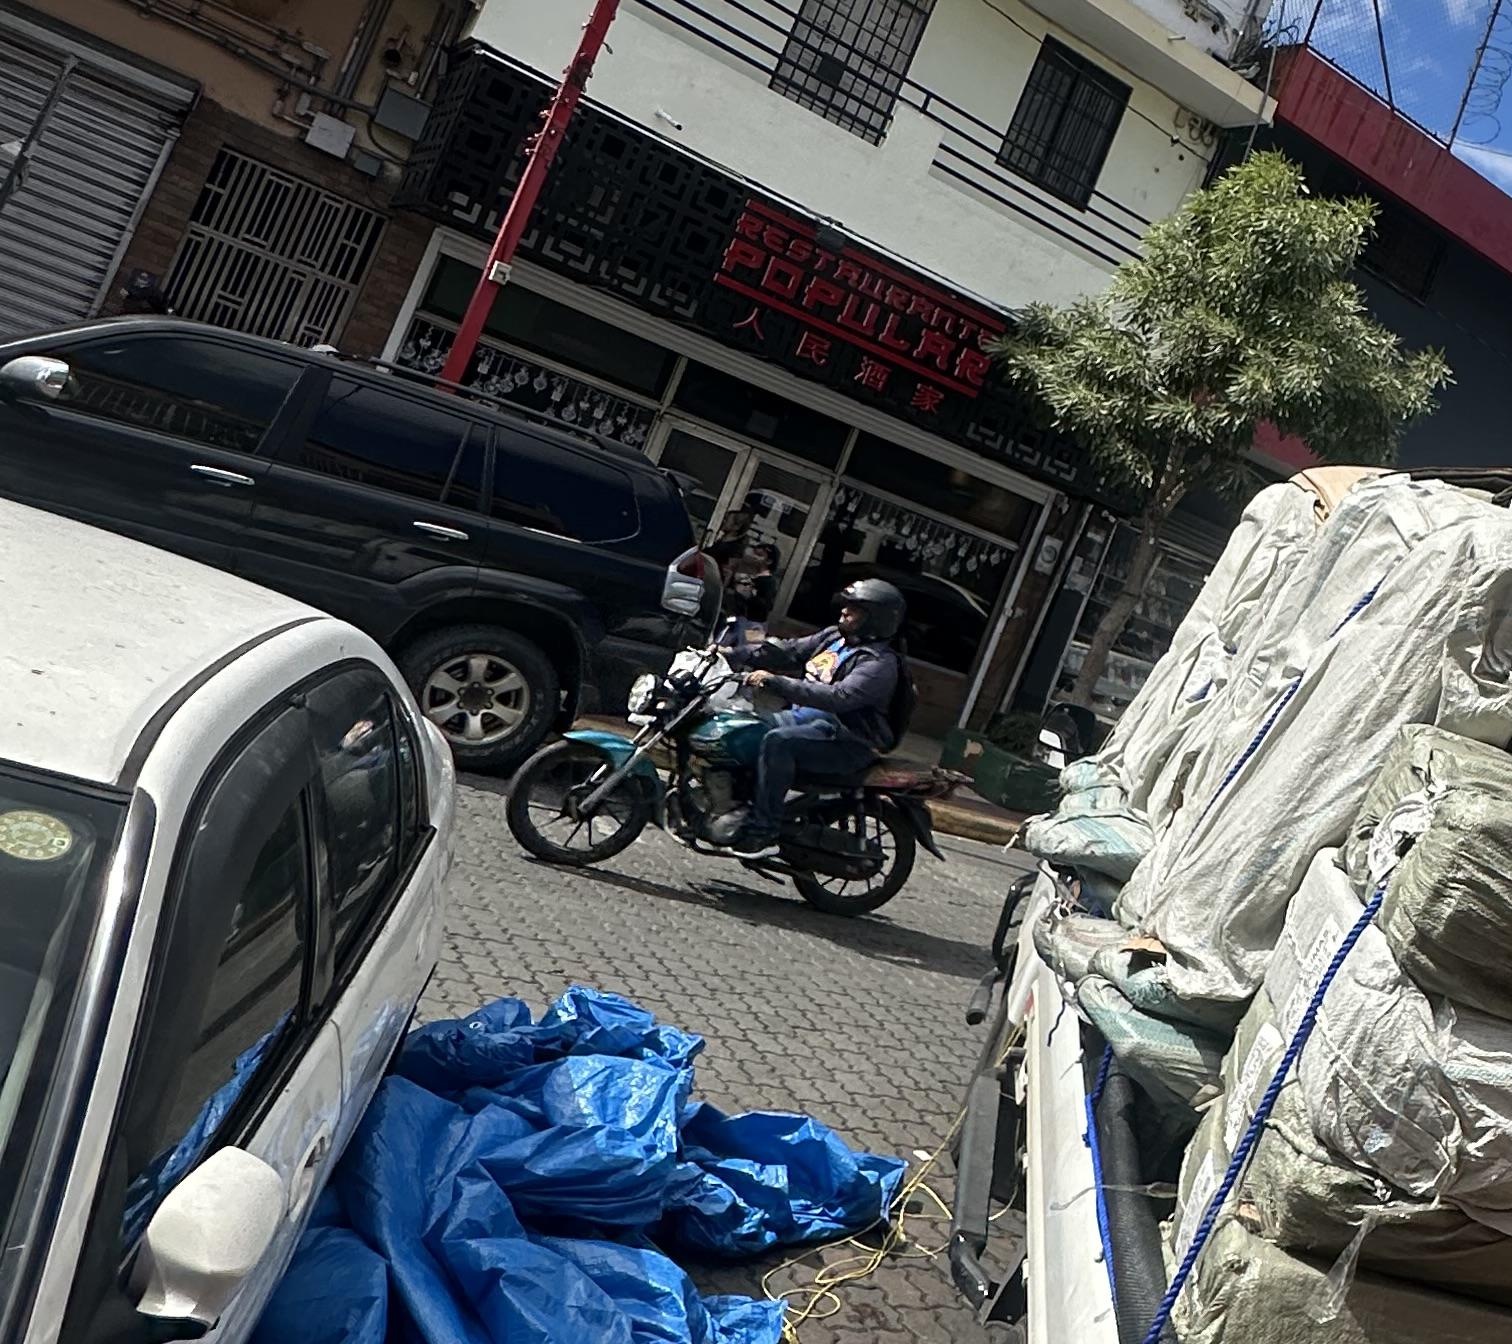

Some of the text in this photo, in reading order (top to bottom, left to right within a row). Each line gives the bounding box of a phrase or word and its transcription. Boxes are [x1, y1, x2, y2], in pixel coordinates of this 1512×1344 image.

[720, 238, 992, 386] POPULAR
[735, 211, 996, 351] RESTAURANTE
[733, 306, 945, 414] 人民酒家
